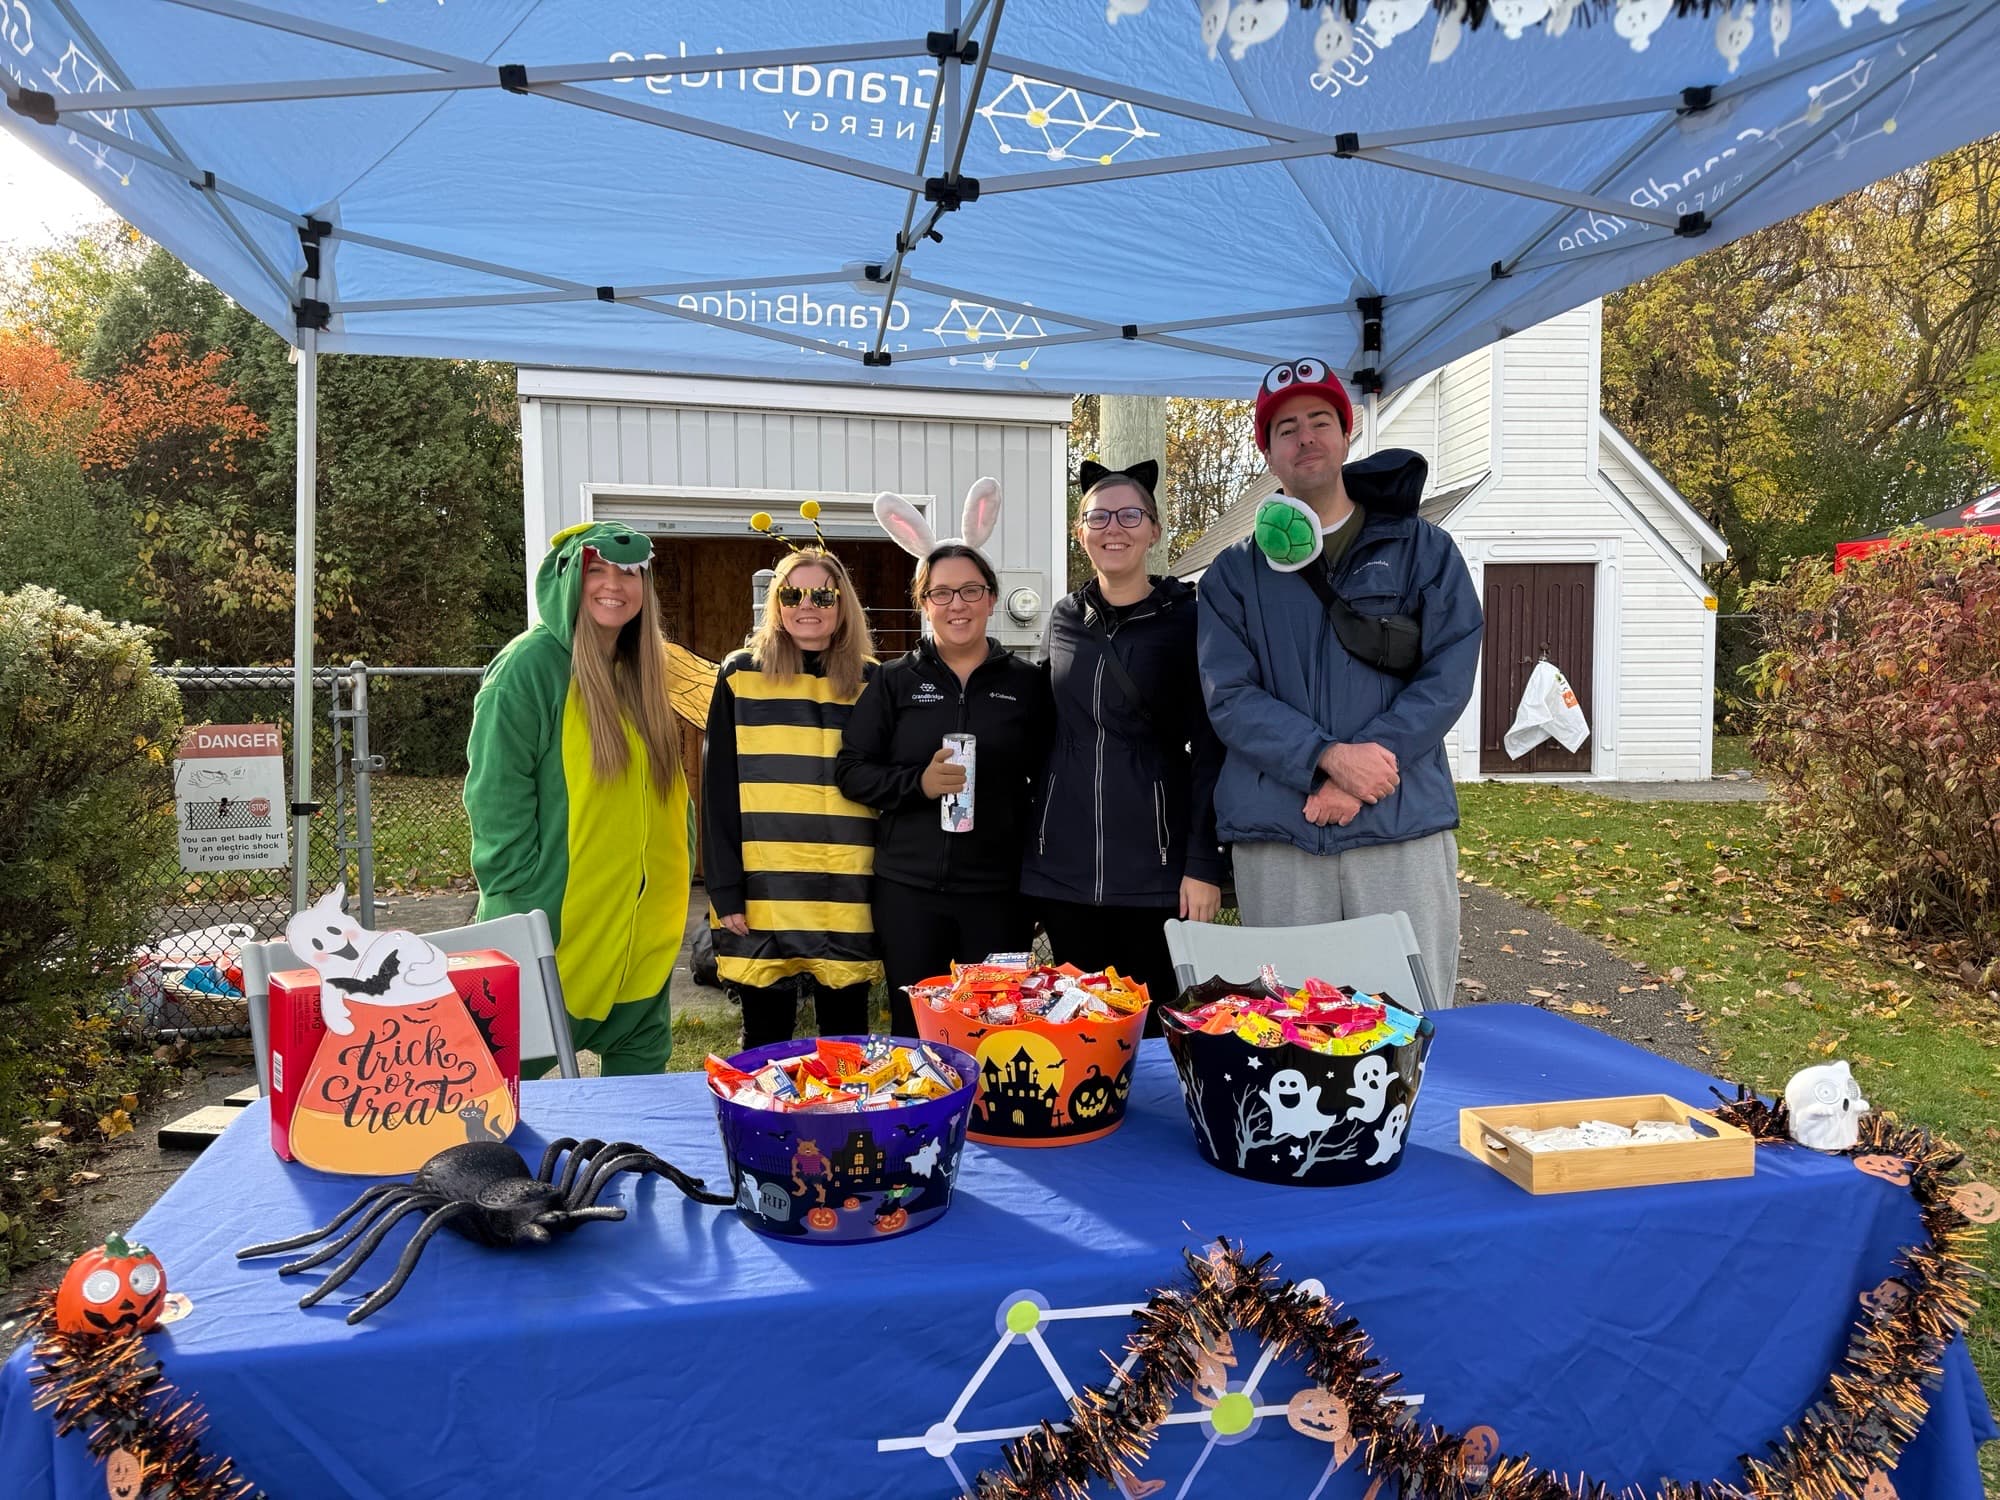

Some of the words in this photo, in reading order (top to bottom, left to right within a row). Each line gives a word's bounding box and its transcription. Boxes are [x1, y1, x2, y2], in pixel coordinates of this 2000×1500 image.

[198, 733, 279, 749] DANGER
[250, 803, 268, 813] STOP
[182, 836, 198, 844] You
[220, 834, 235, 843] get
[238, 833, 263, 842] badly
[265, 832, 284, 841] hurt
[187, 845, 199, 854] by
[216, 843, 250, 852] electric
[252, 841, 280, 850] shock
[199, 854, 205, 862] if
[208, 854, 225, 863] you
[228, 854, 240, 862] go
[242, 851, 270, 860] inside
[384, 1071, 419, 1097] or
[763, 1192, 788, 1210] RIP
